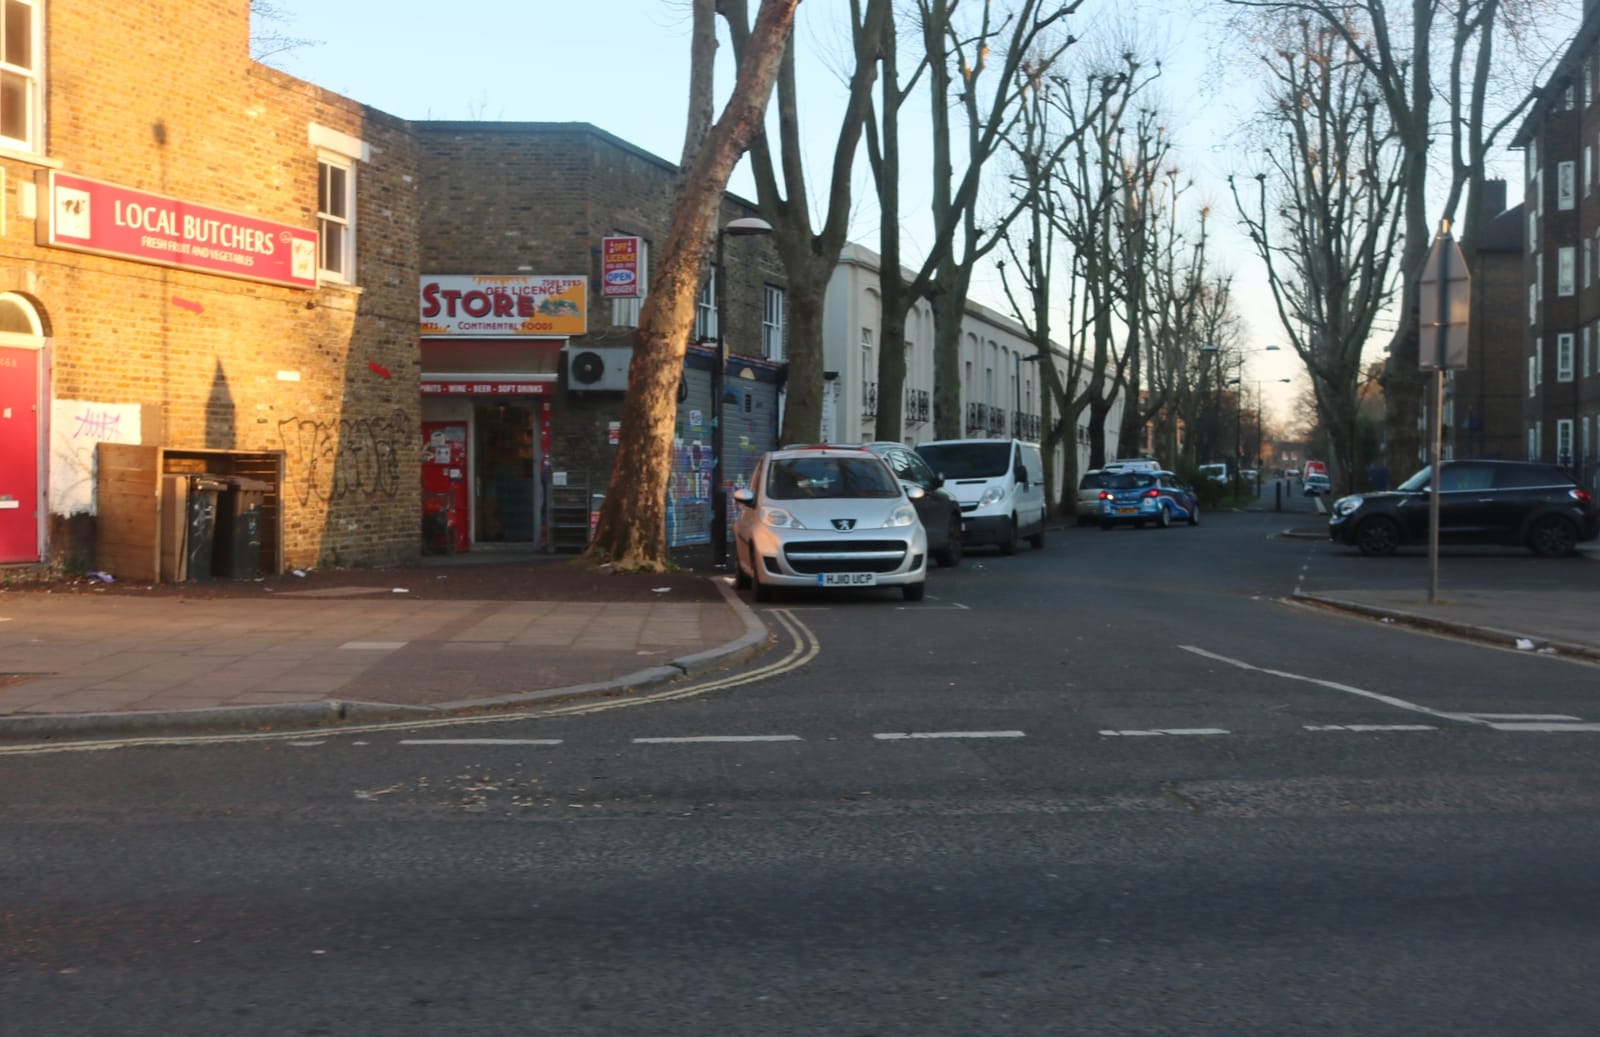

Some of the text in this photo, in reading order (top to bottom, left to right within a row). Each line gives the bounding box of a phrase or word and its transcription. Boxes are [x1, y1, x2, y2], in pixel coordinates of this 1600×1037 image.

[115, 200, 275, 255] LOCAL BUTCHERS
[141, 236, 254, 267] FRESH FRUIT AND VEGETABLES
[614, 243, 627, 252] OFF
[606, 253, 636, 262] LICENCE
[607, 272, 632, 282] OPEN
[485, 286, 563, 296] OFF LICENCE
[457, 321, 518, 330] CONTINENTAL
[521, 322, 552, 330] FOODS
[448, 385, 466, 393] WINE
[473, 385, 491, 393] BEER
[498, 385, 515, 393] SOFT
[517, 385, 543, 393] DRINKS
[852, 574, 873, 584] UCP
